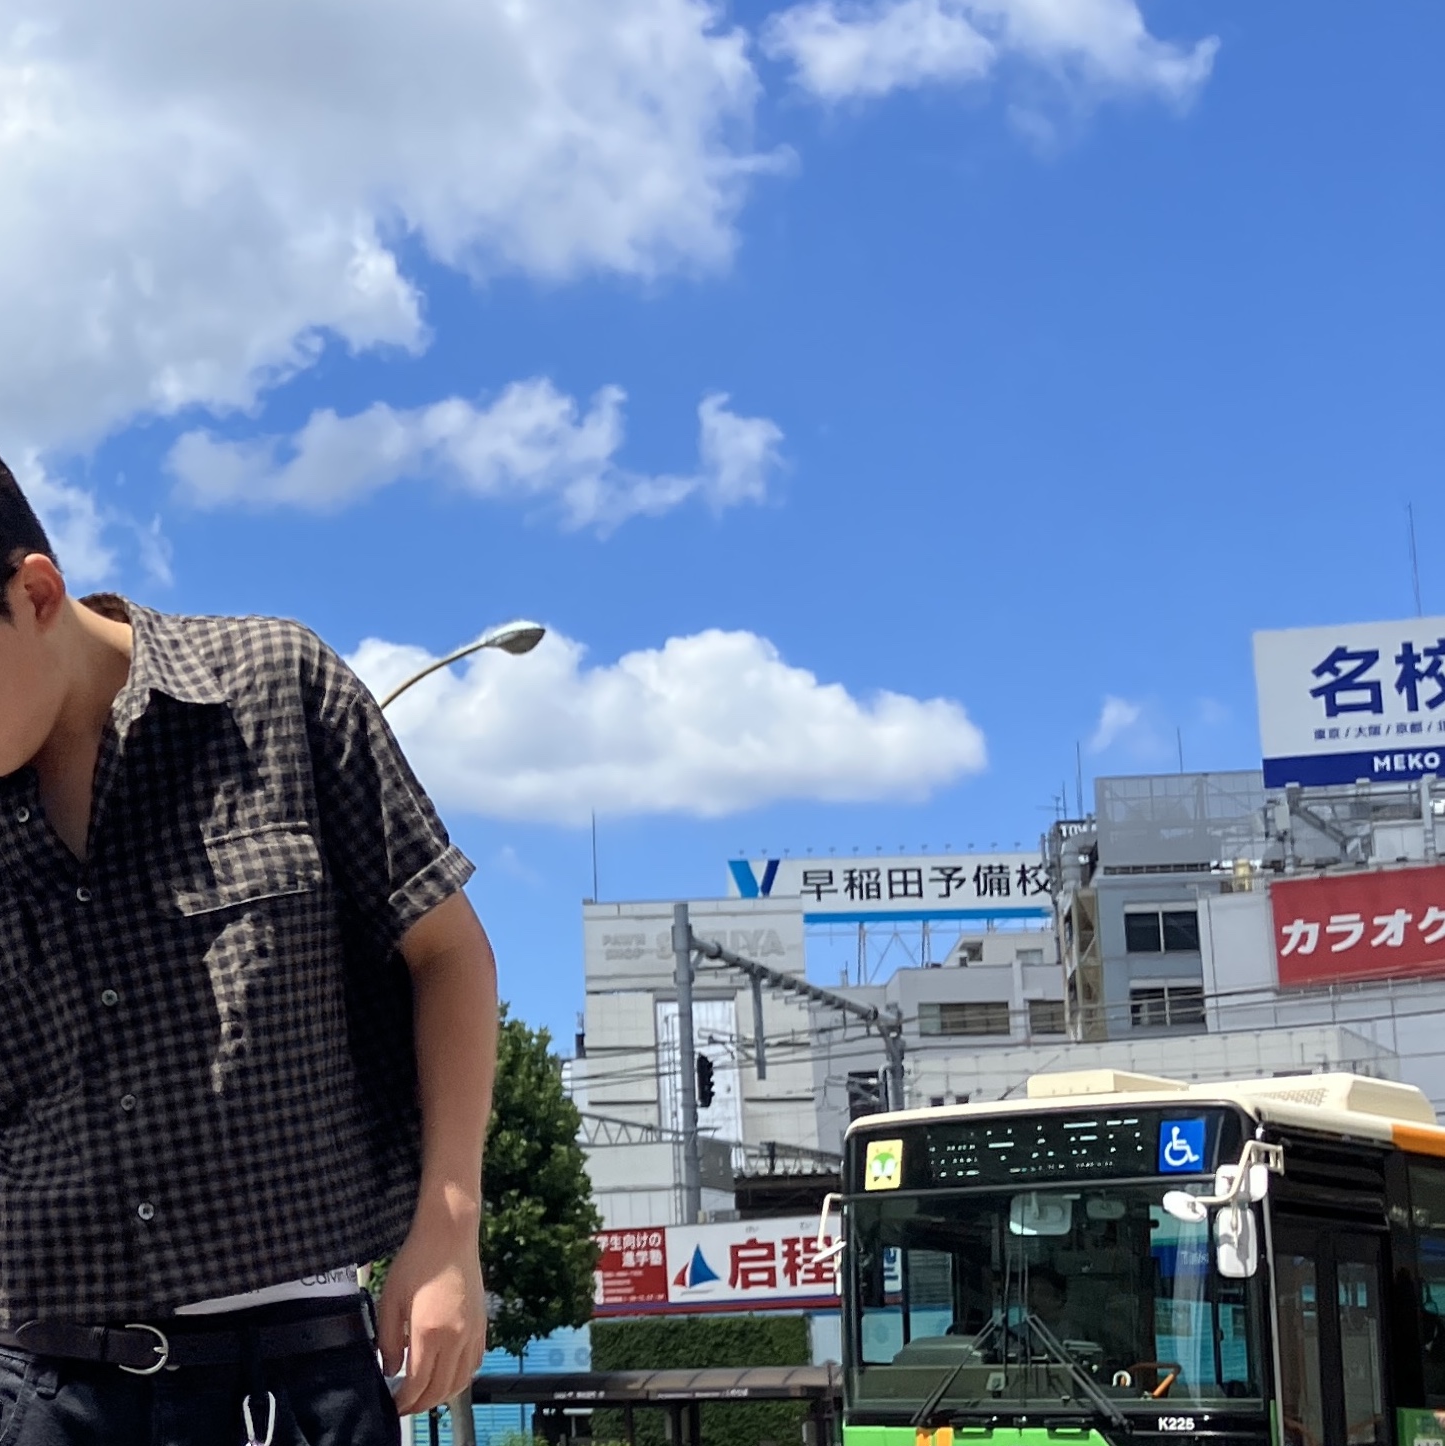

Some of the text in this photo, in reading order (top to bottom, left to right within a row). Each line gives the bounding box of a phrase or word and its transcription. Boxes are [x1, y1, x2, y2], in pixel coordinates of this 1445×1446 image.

[1372, 751, 1441, 773] MEKO
[800, 862, 1054, 902] 早稲田予備校
[1158, 1416, 1195, 1431] K225
